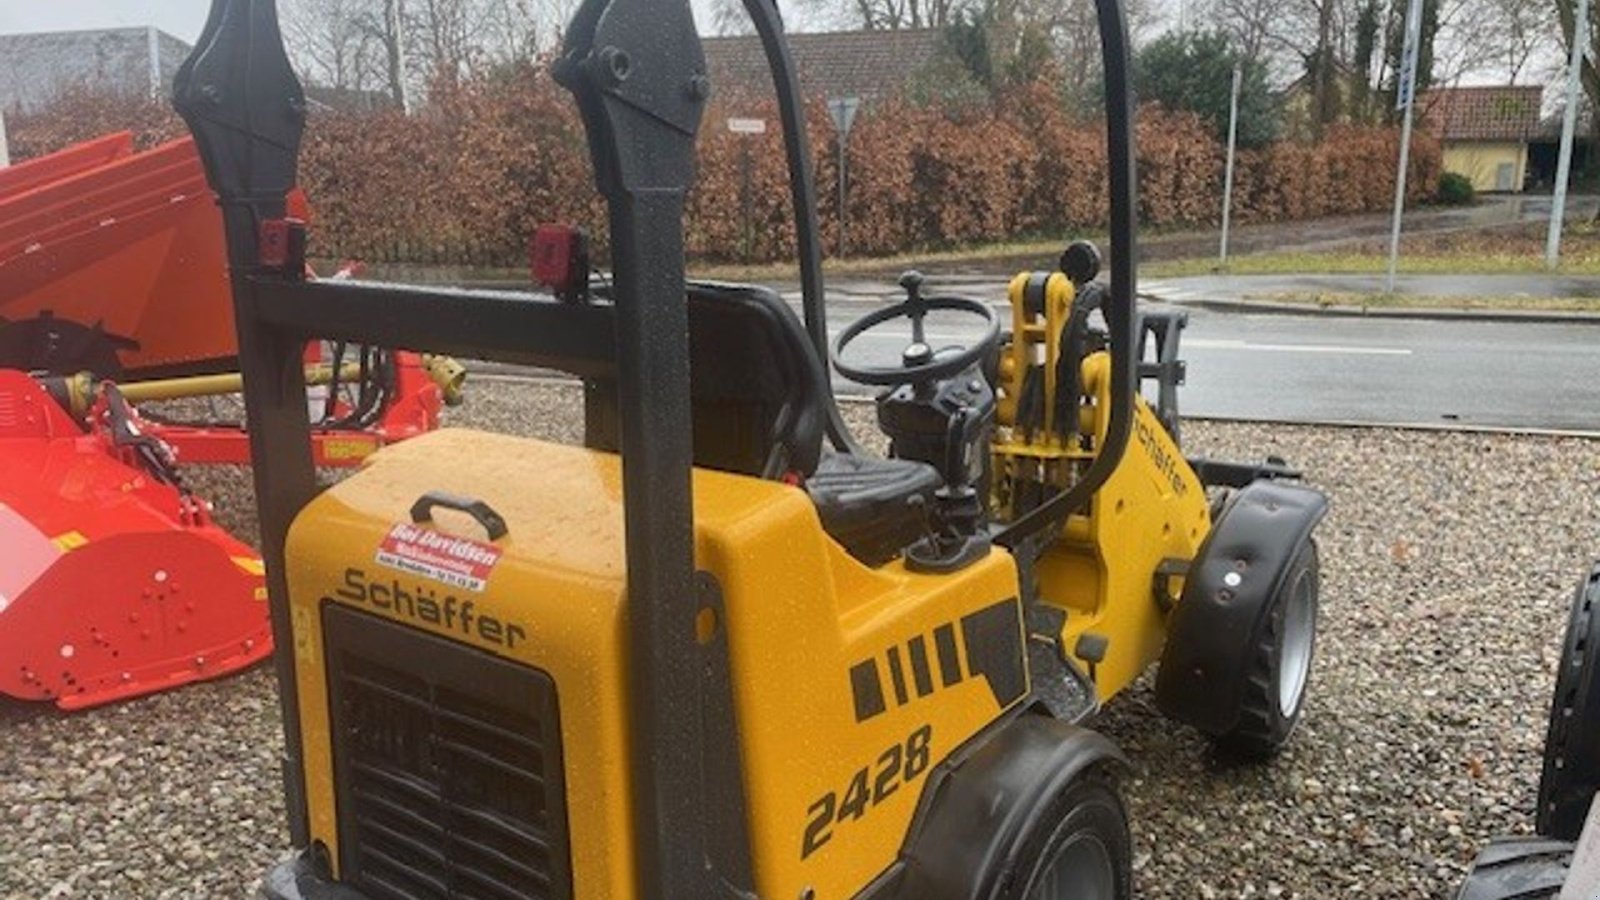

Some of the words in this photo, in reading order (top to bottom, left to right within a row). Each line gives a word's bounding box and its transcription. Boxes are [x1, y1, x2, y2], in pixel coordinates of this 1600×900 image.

[420, 531, 498, 566] Davidsen
[337, 567, 526, 648] Schäffer
[801, 724, 932, 861] 2428
